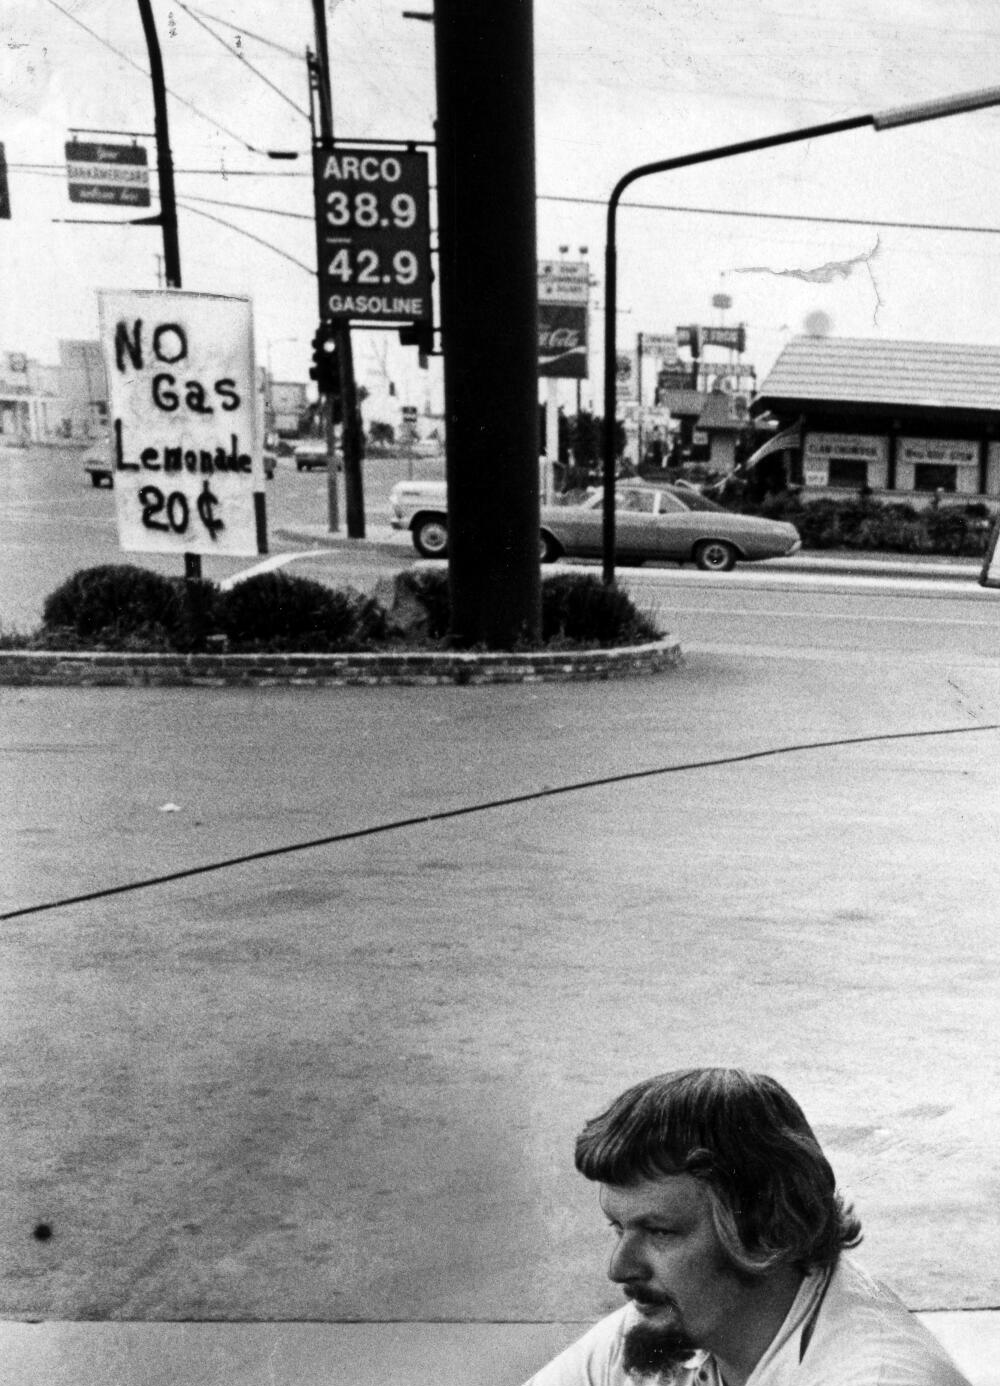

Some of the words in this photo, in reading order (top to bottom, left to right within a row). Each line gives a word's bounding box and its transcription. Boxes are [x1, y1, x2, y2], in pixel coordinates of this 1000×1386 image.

[323, 155, 401, 182] ARCO
[326, 191, 416, 228] 38.9
[328, 249, 418, 285] 42.9
[328, 294, 423, 315] GASOLINE
[115, 319, 188, 373] NO
[152, 373, 241, 415] Gas
[114, 418, 252, 475] Lemonade
